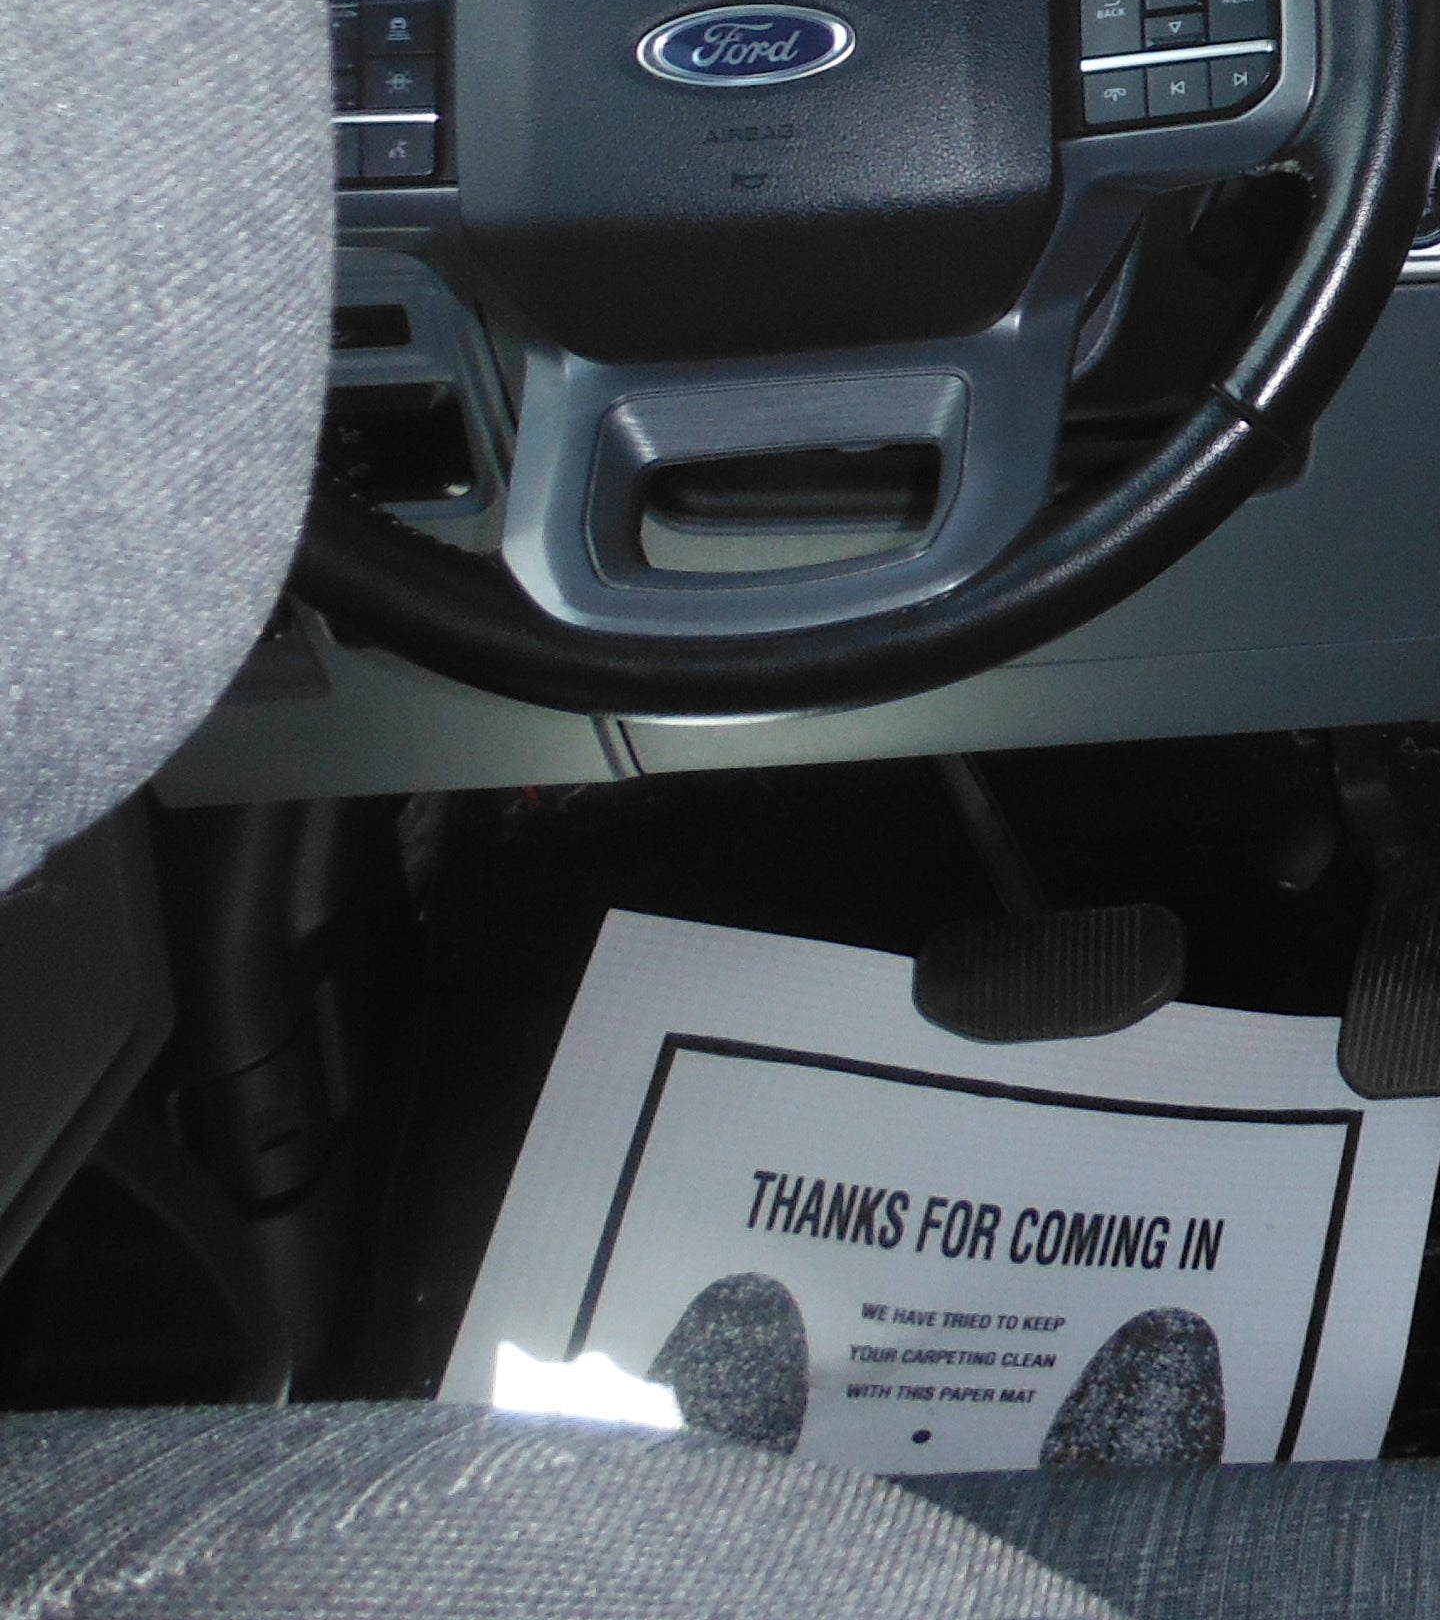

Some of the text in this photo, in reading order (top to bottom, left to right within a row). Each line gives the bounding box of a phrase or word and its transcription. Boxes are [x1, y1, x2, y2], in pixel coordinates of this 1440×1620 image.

[1096, 7, 1127, 20] BACK
[691, 22, 801, 68] Ford
[745, 1170, 1226, 1271] THANKS FOR COMING IN
[861, 1302, 1066, 1333] WE HAVE TRIED TO KEEP
[850, 1344, 1057, 1368] YOUR CARPETING CLEAN
[847, 1383, 1037, 1404] WITH THIS PAPER MAT
